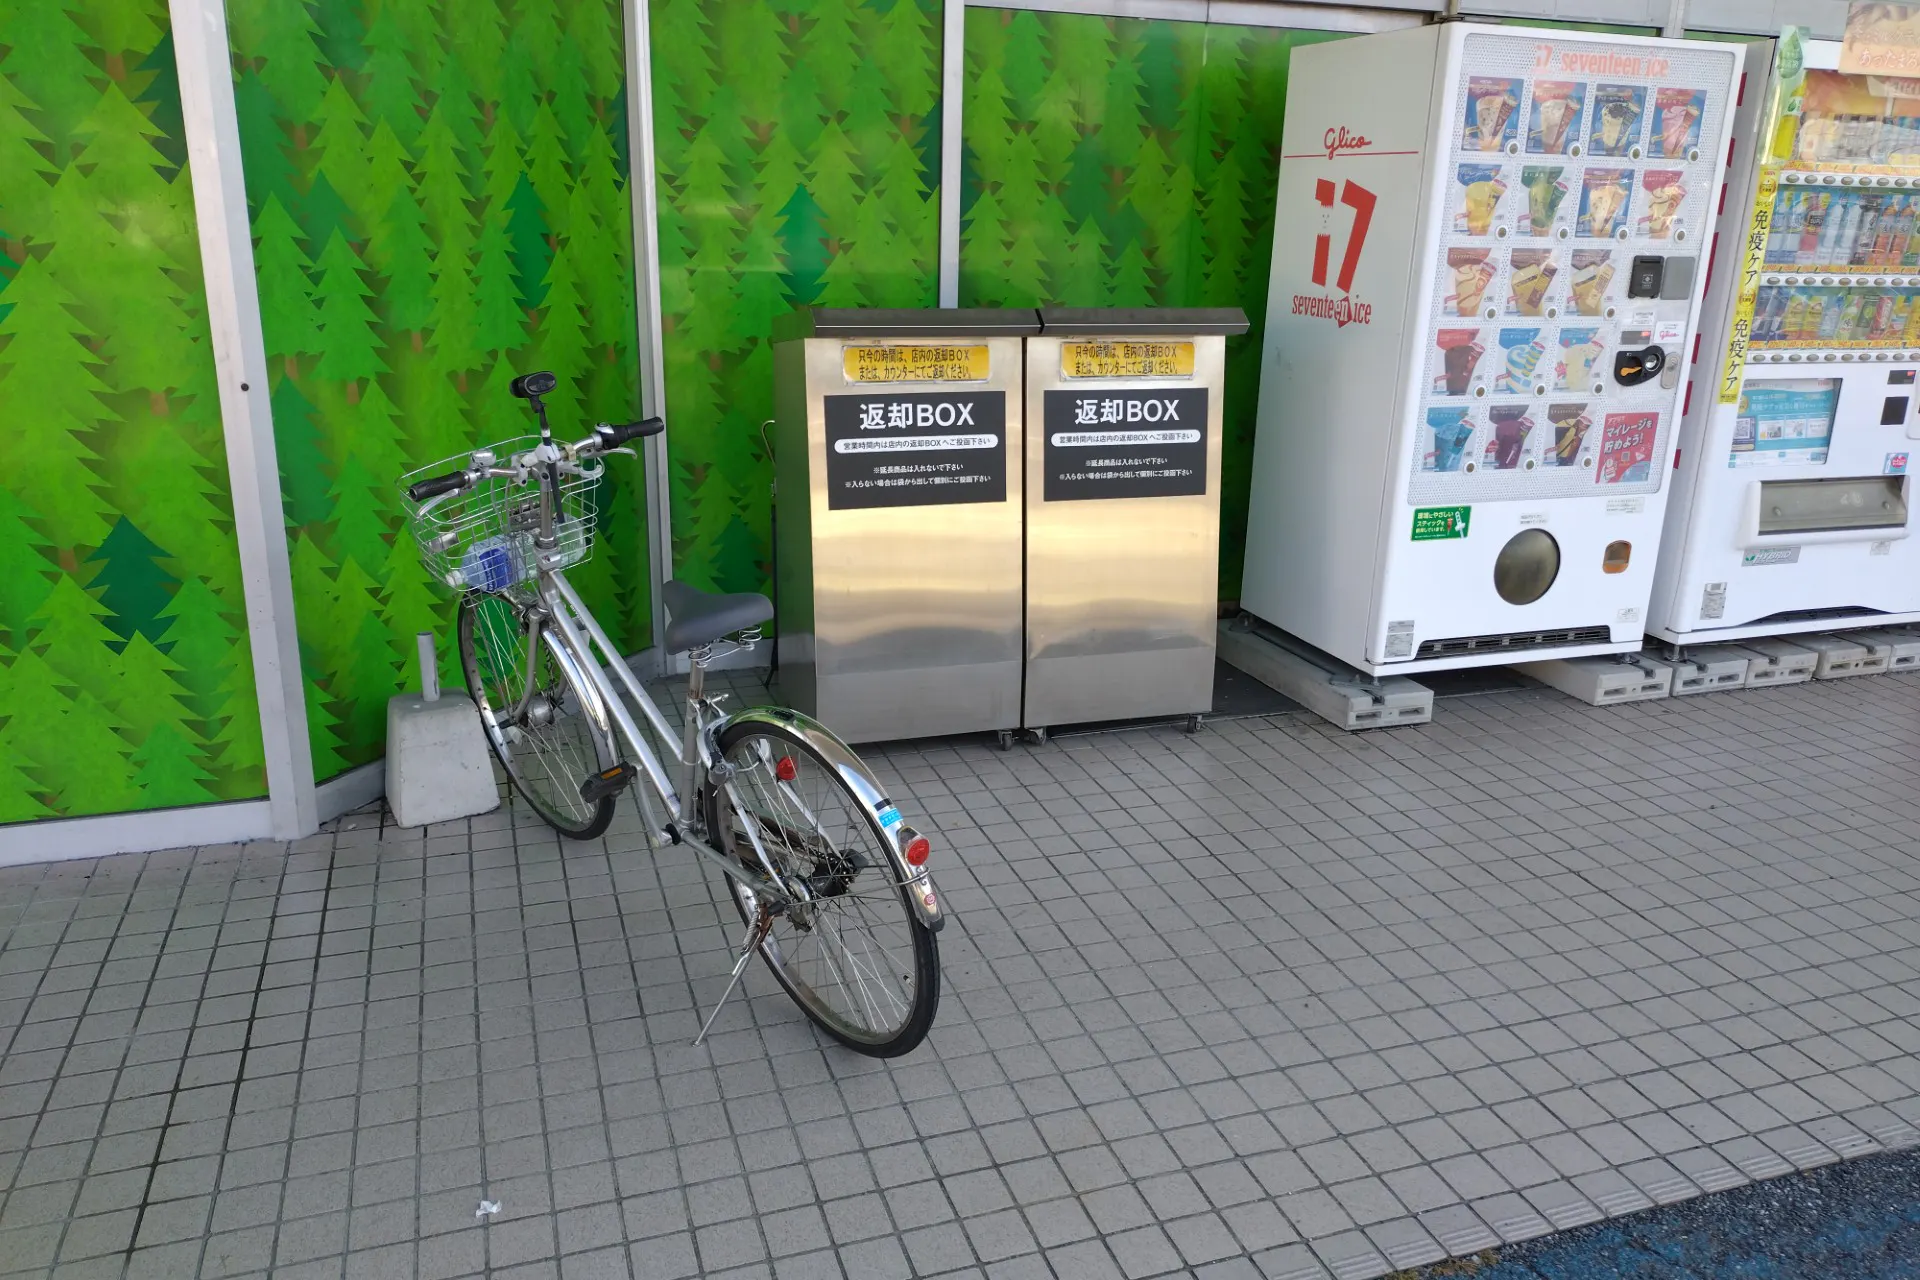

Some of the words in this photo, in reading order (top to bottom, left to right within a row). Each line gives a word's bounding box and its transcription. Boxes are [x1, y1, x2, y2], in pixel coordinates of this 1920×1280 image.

[1561, 51, 1641, 75] seventeen
[1644, 50, 1668, 77] ice
[1324, 126, 1372, 160] Glico
[1745, 209, 1768, 286] 免疫ケア
[1292, 294, 1351, 323] seventeen
[1353, 294, 1372, 324] ice
[1725, 318, 1748, 392] 免疫ケア
[859, 402, 975, 431] 返却BOX
[1074, 398, 1180, 425] 返却BOX
[1606, 417, 1653, 437] マイレージを
[1756, 551, 1792, 560] HYBRID
